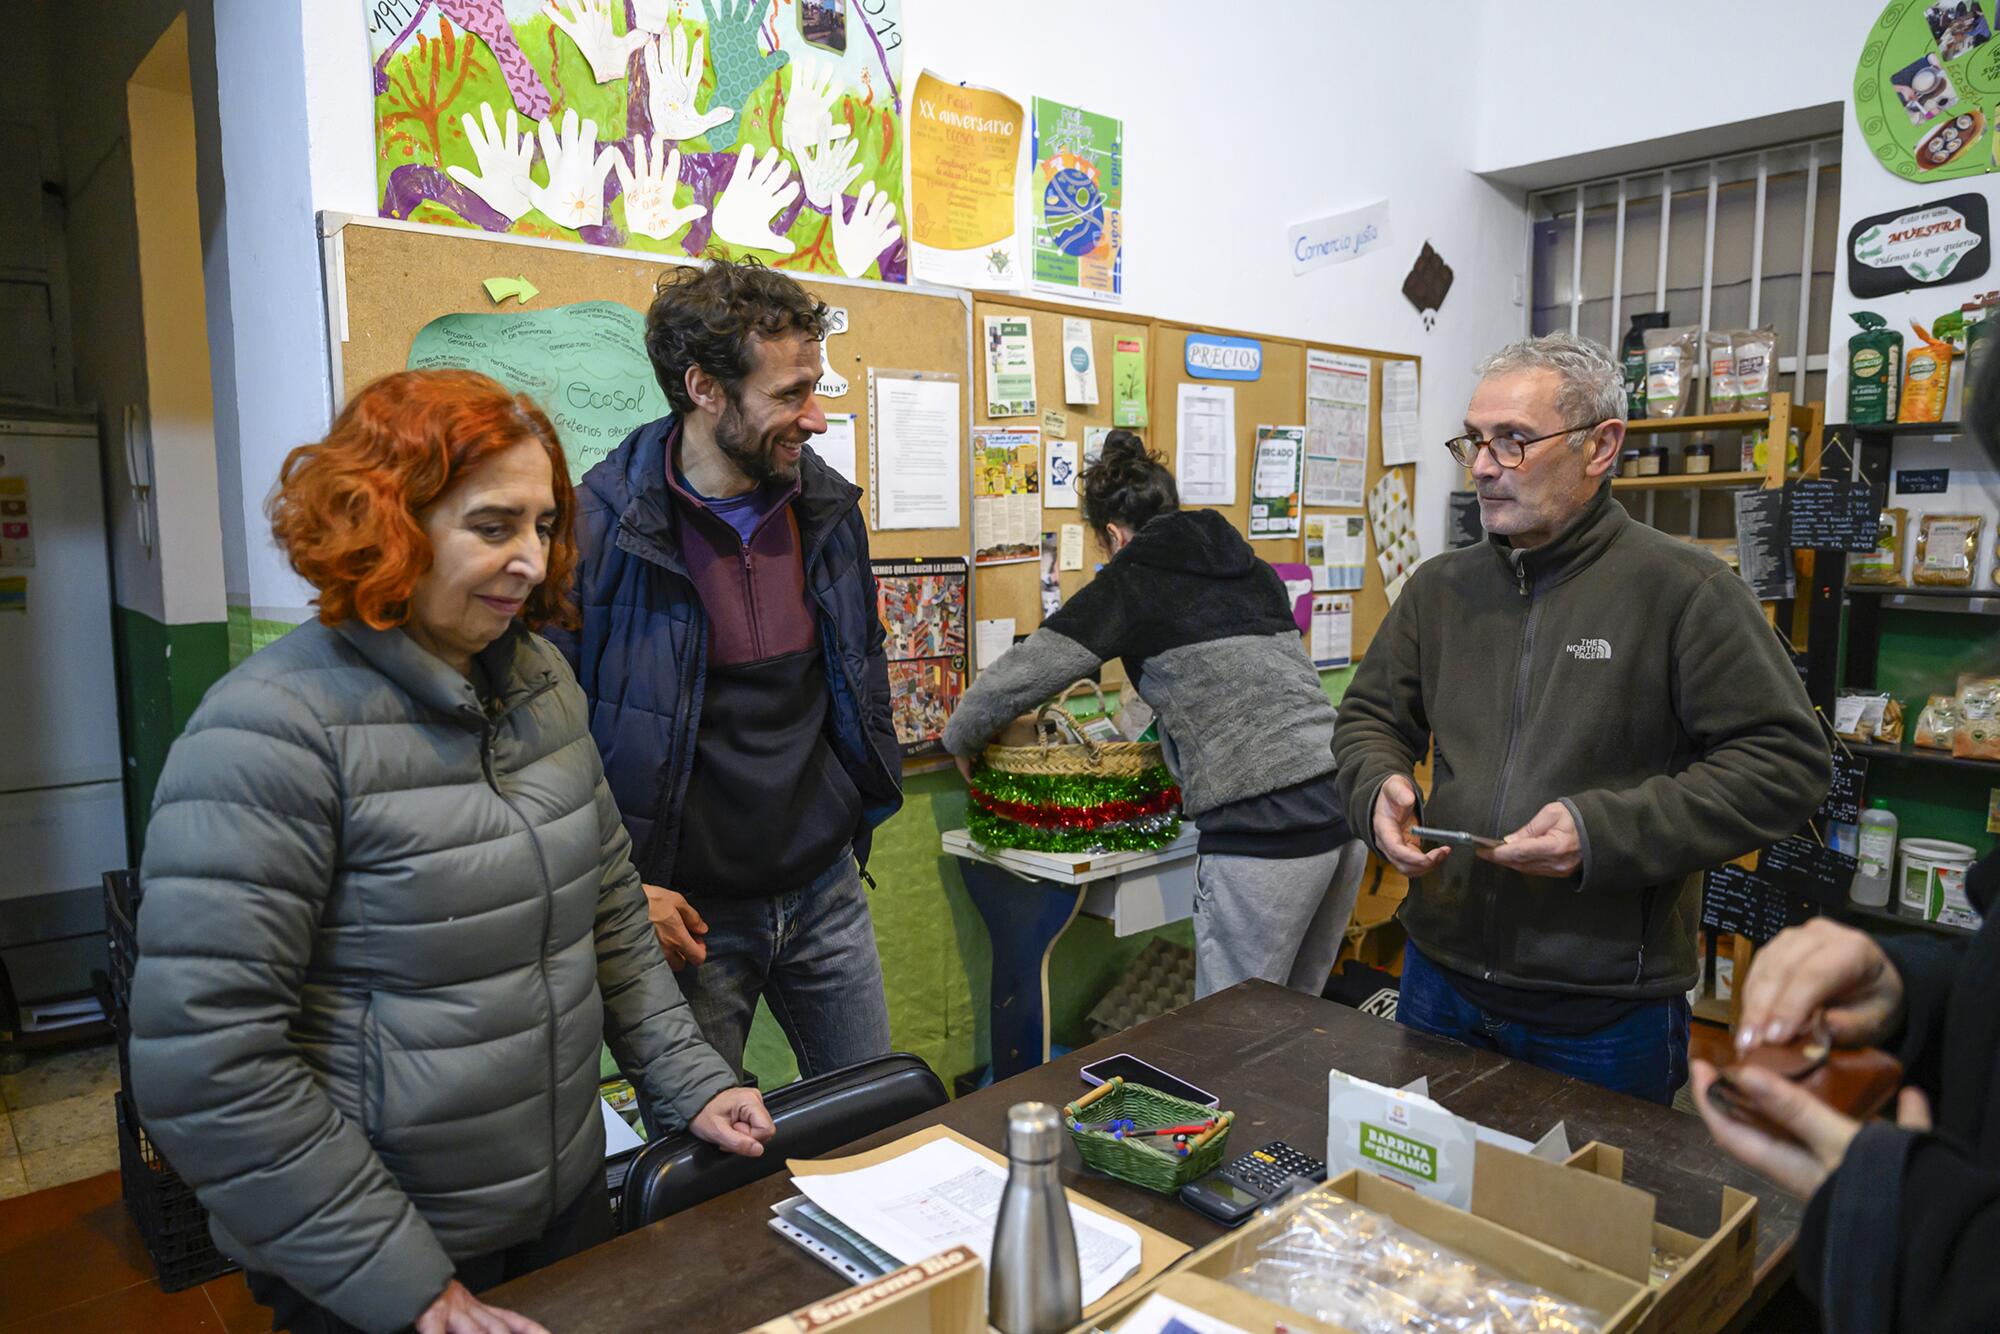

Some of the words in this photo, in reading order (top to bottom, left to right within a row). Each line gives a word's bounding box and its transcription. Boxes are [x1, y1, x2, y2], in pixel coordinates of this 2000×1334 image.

[919, 98, 936, 120] XX
[938, 109, 1014, 137] aniversario
[1900, 215, 1920, 225] Esto
[1932, 207, 1949, 218] una
[1294, 235, 1351, 262] Comercio
[1352, 224, 1378, 255] justo
[1887, 218, 1962, 245] MUESTRA
[1912, 248, 1922, 258] lo
[1924, 246, 1941, 259] que
[1943, 237, 1980, 254] quieras
[1189, 345, 1259, 371] PRECIOS
[554, 412, 602, 438] Criterios
[893, 564, 906, 575] QUE
[906, 562, 933, 574] REDUCIR
[933, 562, 941, 573] LA
[941, 561, 966, 573] BASURA
[1566, 644, 1598, 653] NORTH
[1580, 638, 1598, 646] THE
[1574, 651, 1596, 660] FACE
[1367, 1128, 1431, 1163] BARRITA
[808, 1267, 926, 1325] Supreme
[922, 1250, 966, 1278] Bio
